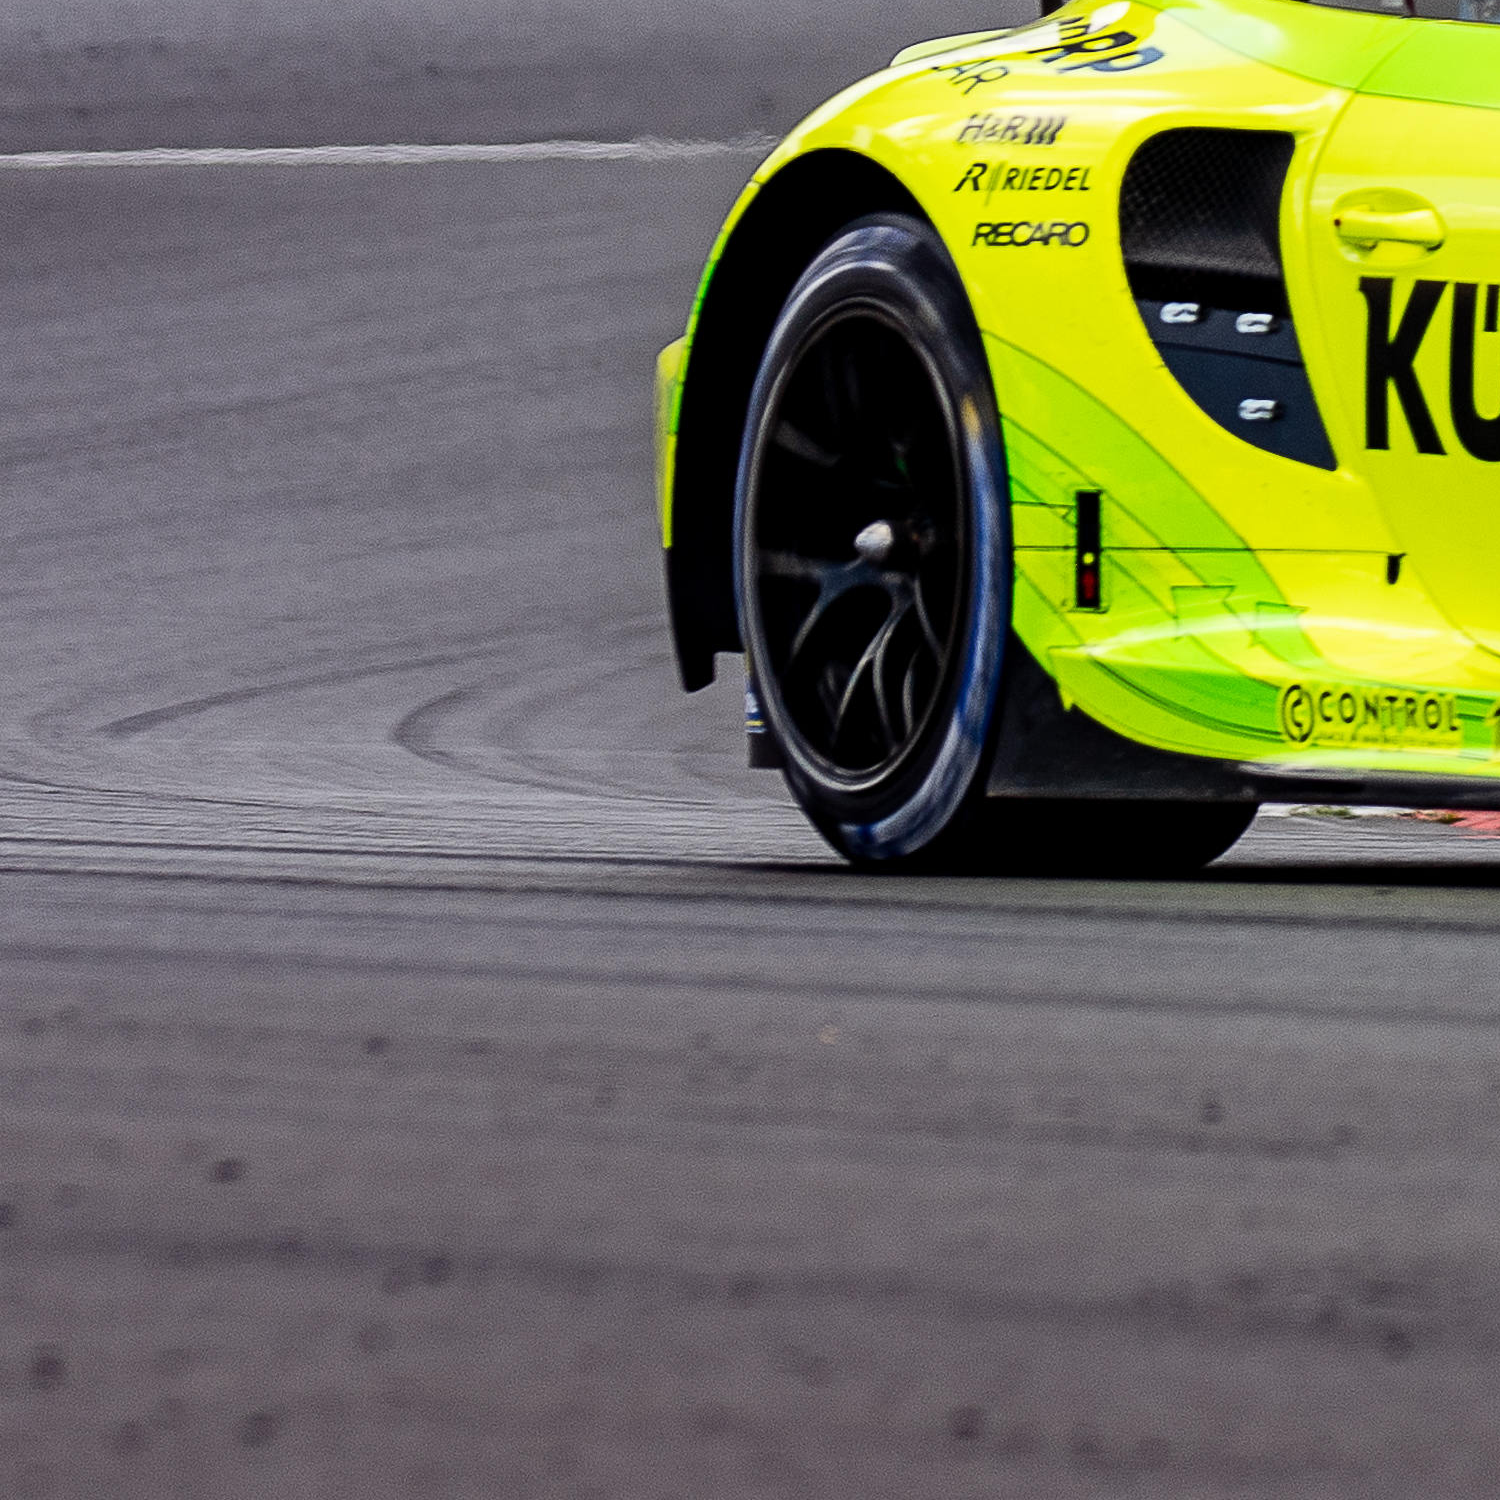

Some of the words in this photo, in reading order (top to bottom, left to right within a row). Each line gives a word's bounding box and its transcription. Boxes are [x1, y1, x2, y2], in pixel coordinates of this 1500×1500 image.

[1001, 166, 1092, 193] RIEDEL
[971, 221, 1091, 248] RECARO
[1317, 688, 1461, 733] CONTROL
